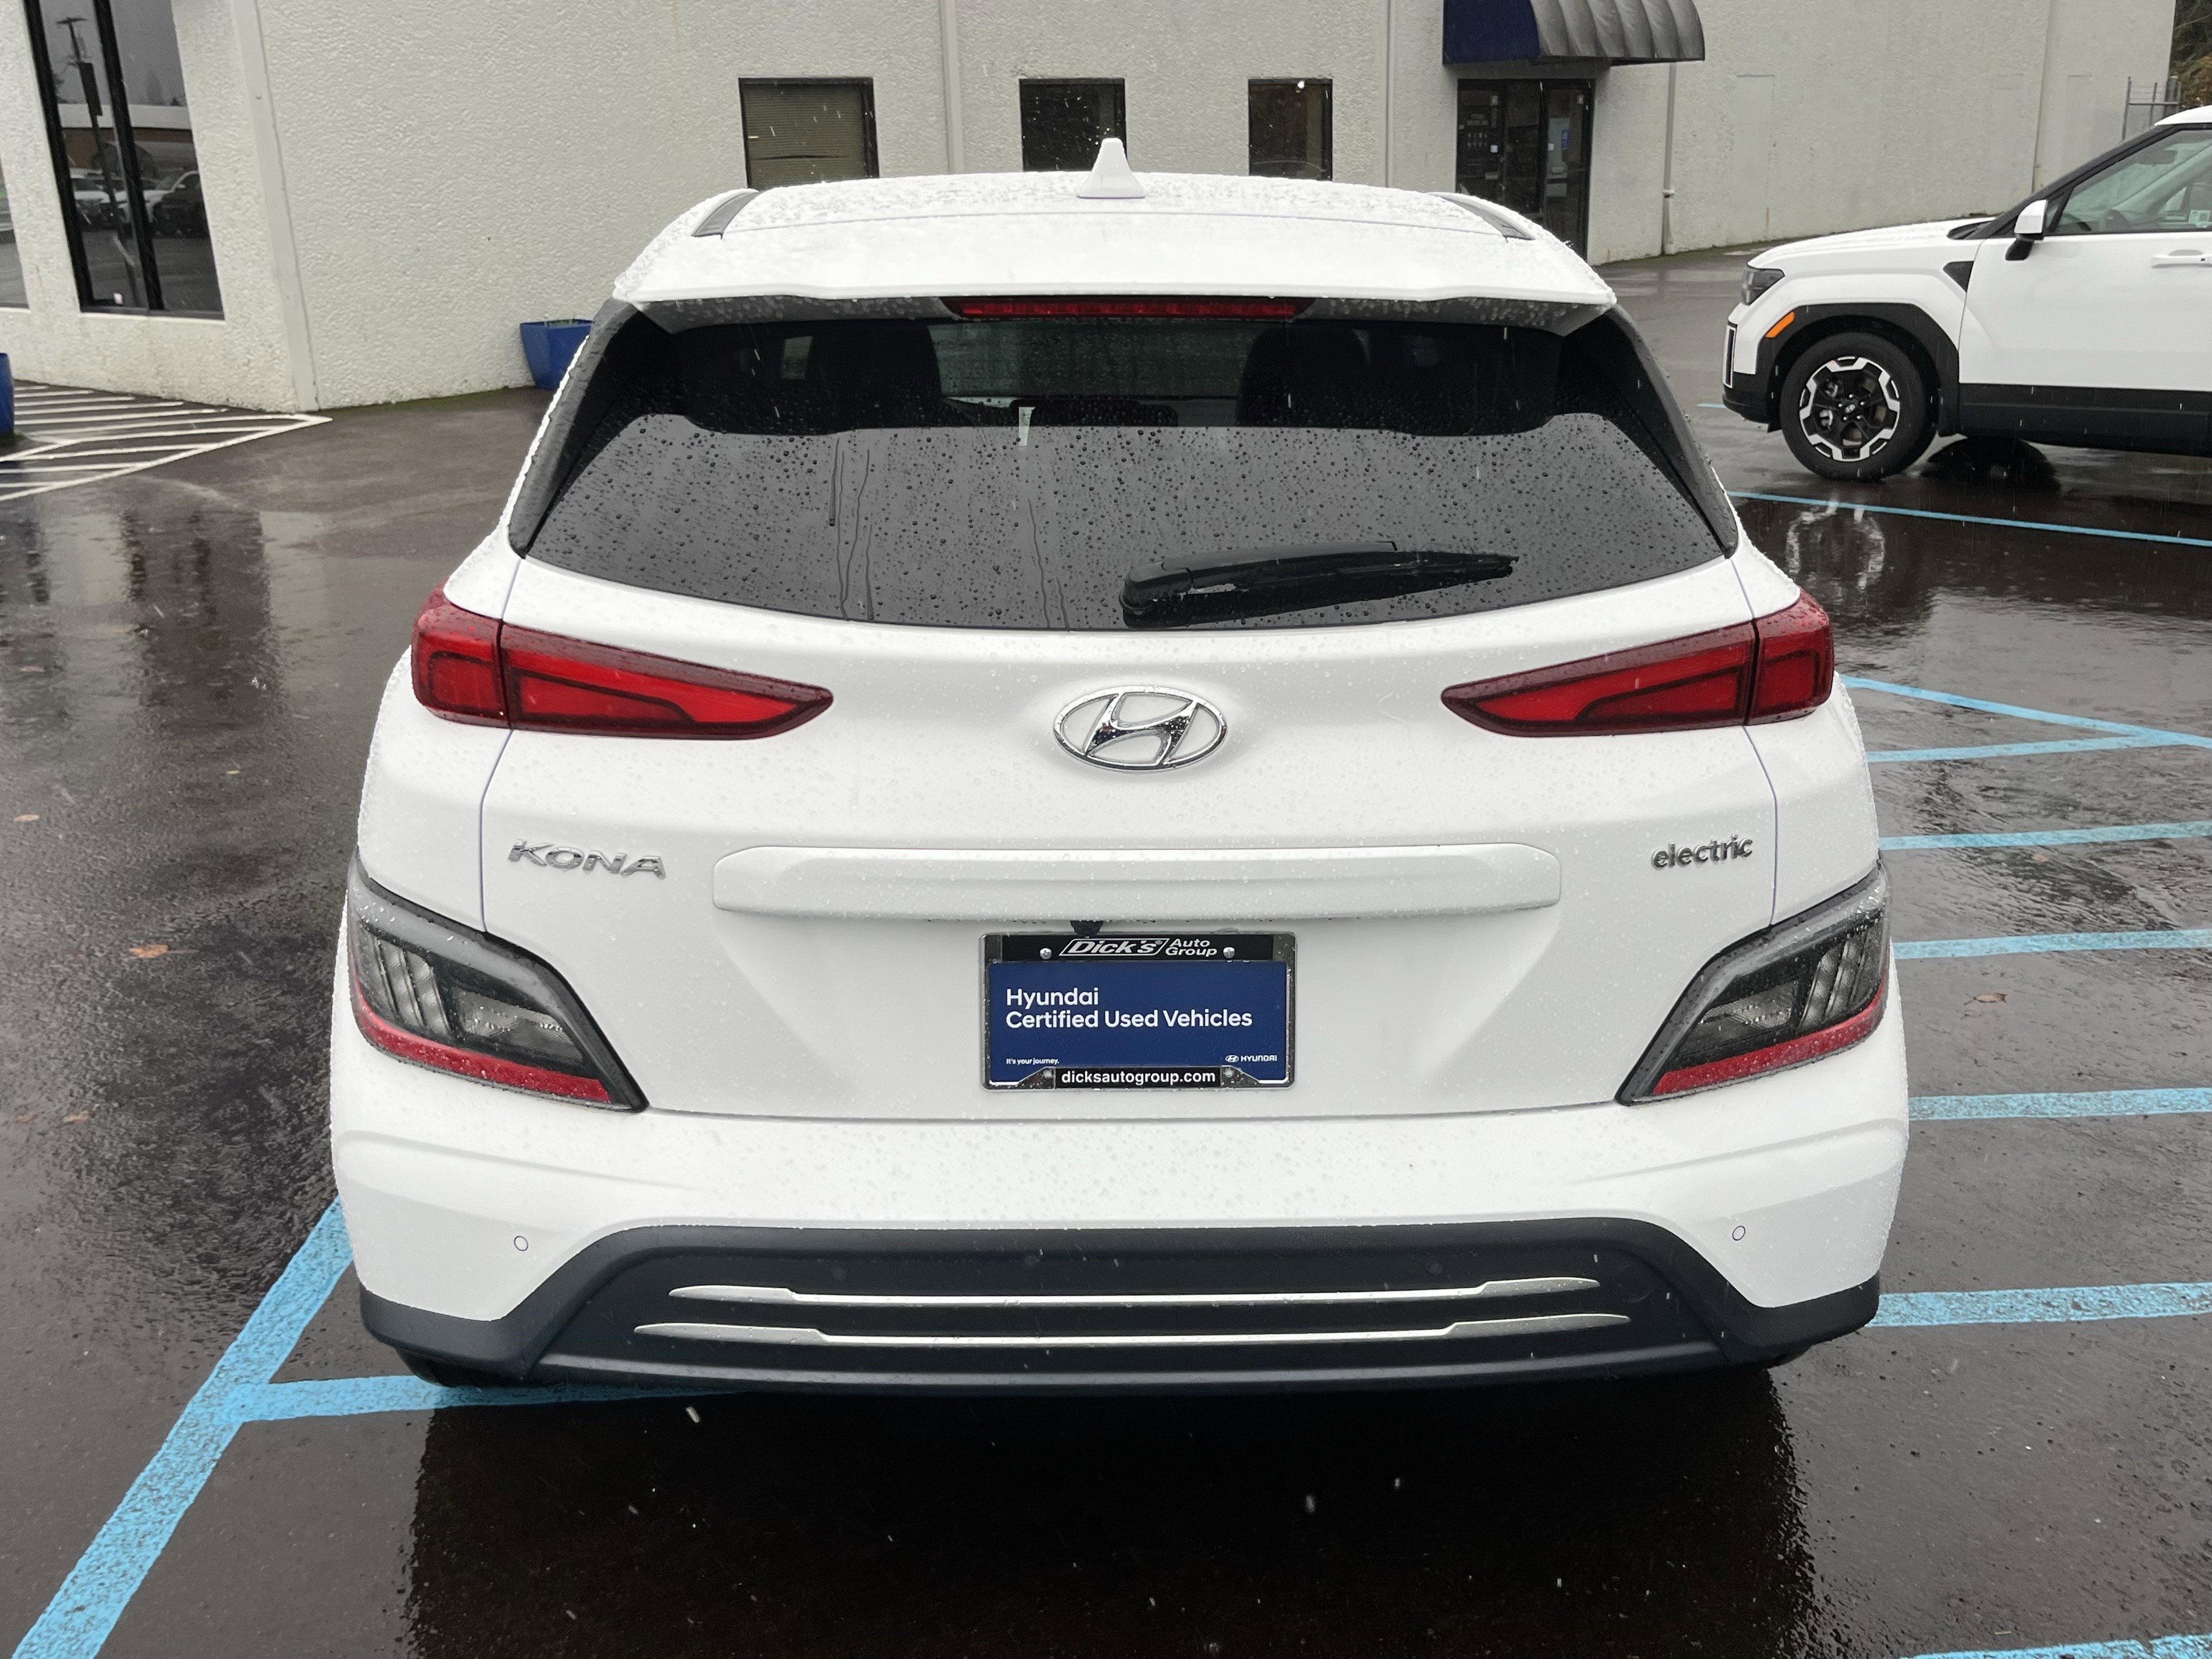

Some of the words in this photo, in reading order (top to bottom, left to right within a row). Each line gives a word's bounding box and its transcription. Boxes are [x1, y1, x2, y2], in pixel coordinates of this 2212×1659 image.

[507, 838, 667, 880] KONA
[1651, 833, 1753, 871] electric
[1165, 947, 1217, 957] Group
[1169, 939, 1210, 947] Auto
[1006, 988, 1099, 1009] Hyundai
[1006, 1009, 1099, 1028] Certified
[1104, 1009, 1159, 1028] Used
[1163, 1009, 1252, 1027] Vehicles
[1061, 1070, 1216, 1086] dicksautogroup.com
